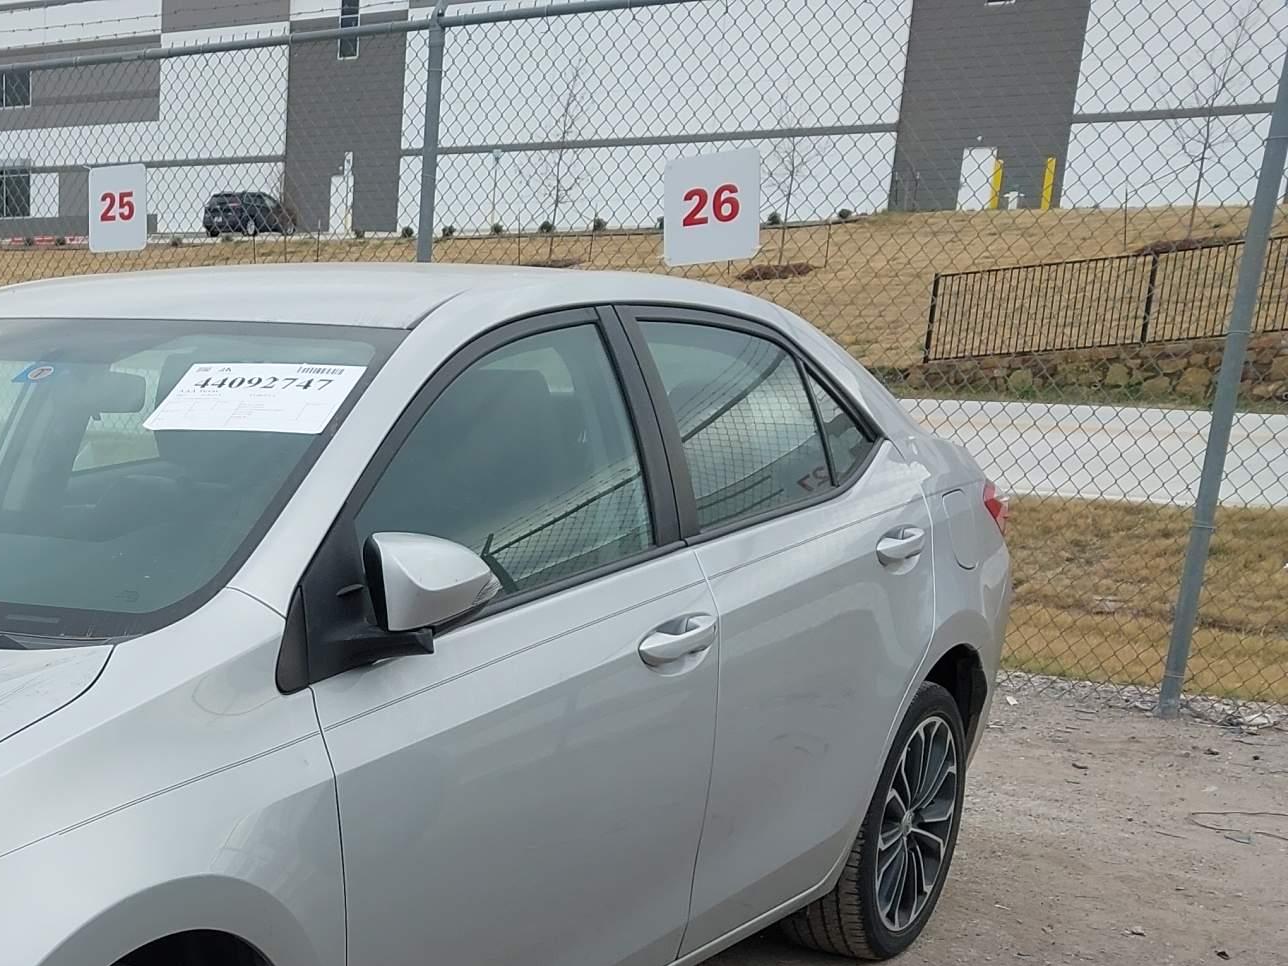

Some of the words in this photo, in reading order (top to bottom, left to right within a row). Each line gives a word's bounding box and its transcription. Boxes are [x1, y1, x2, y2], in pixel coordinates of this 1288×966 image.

[100, 191, 135, 222] 25
[682, 183, 740, 227] 26
[194, 375, 336, 391] 44092747
